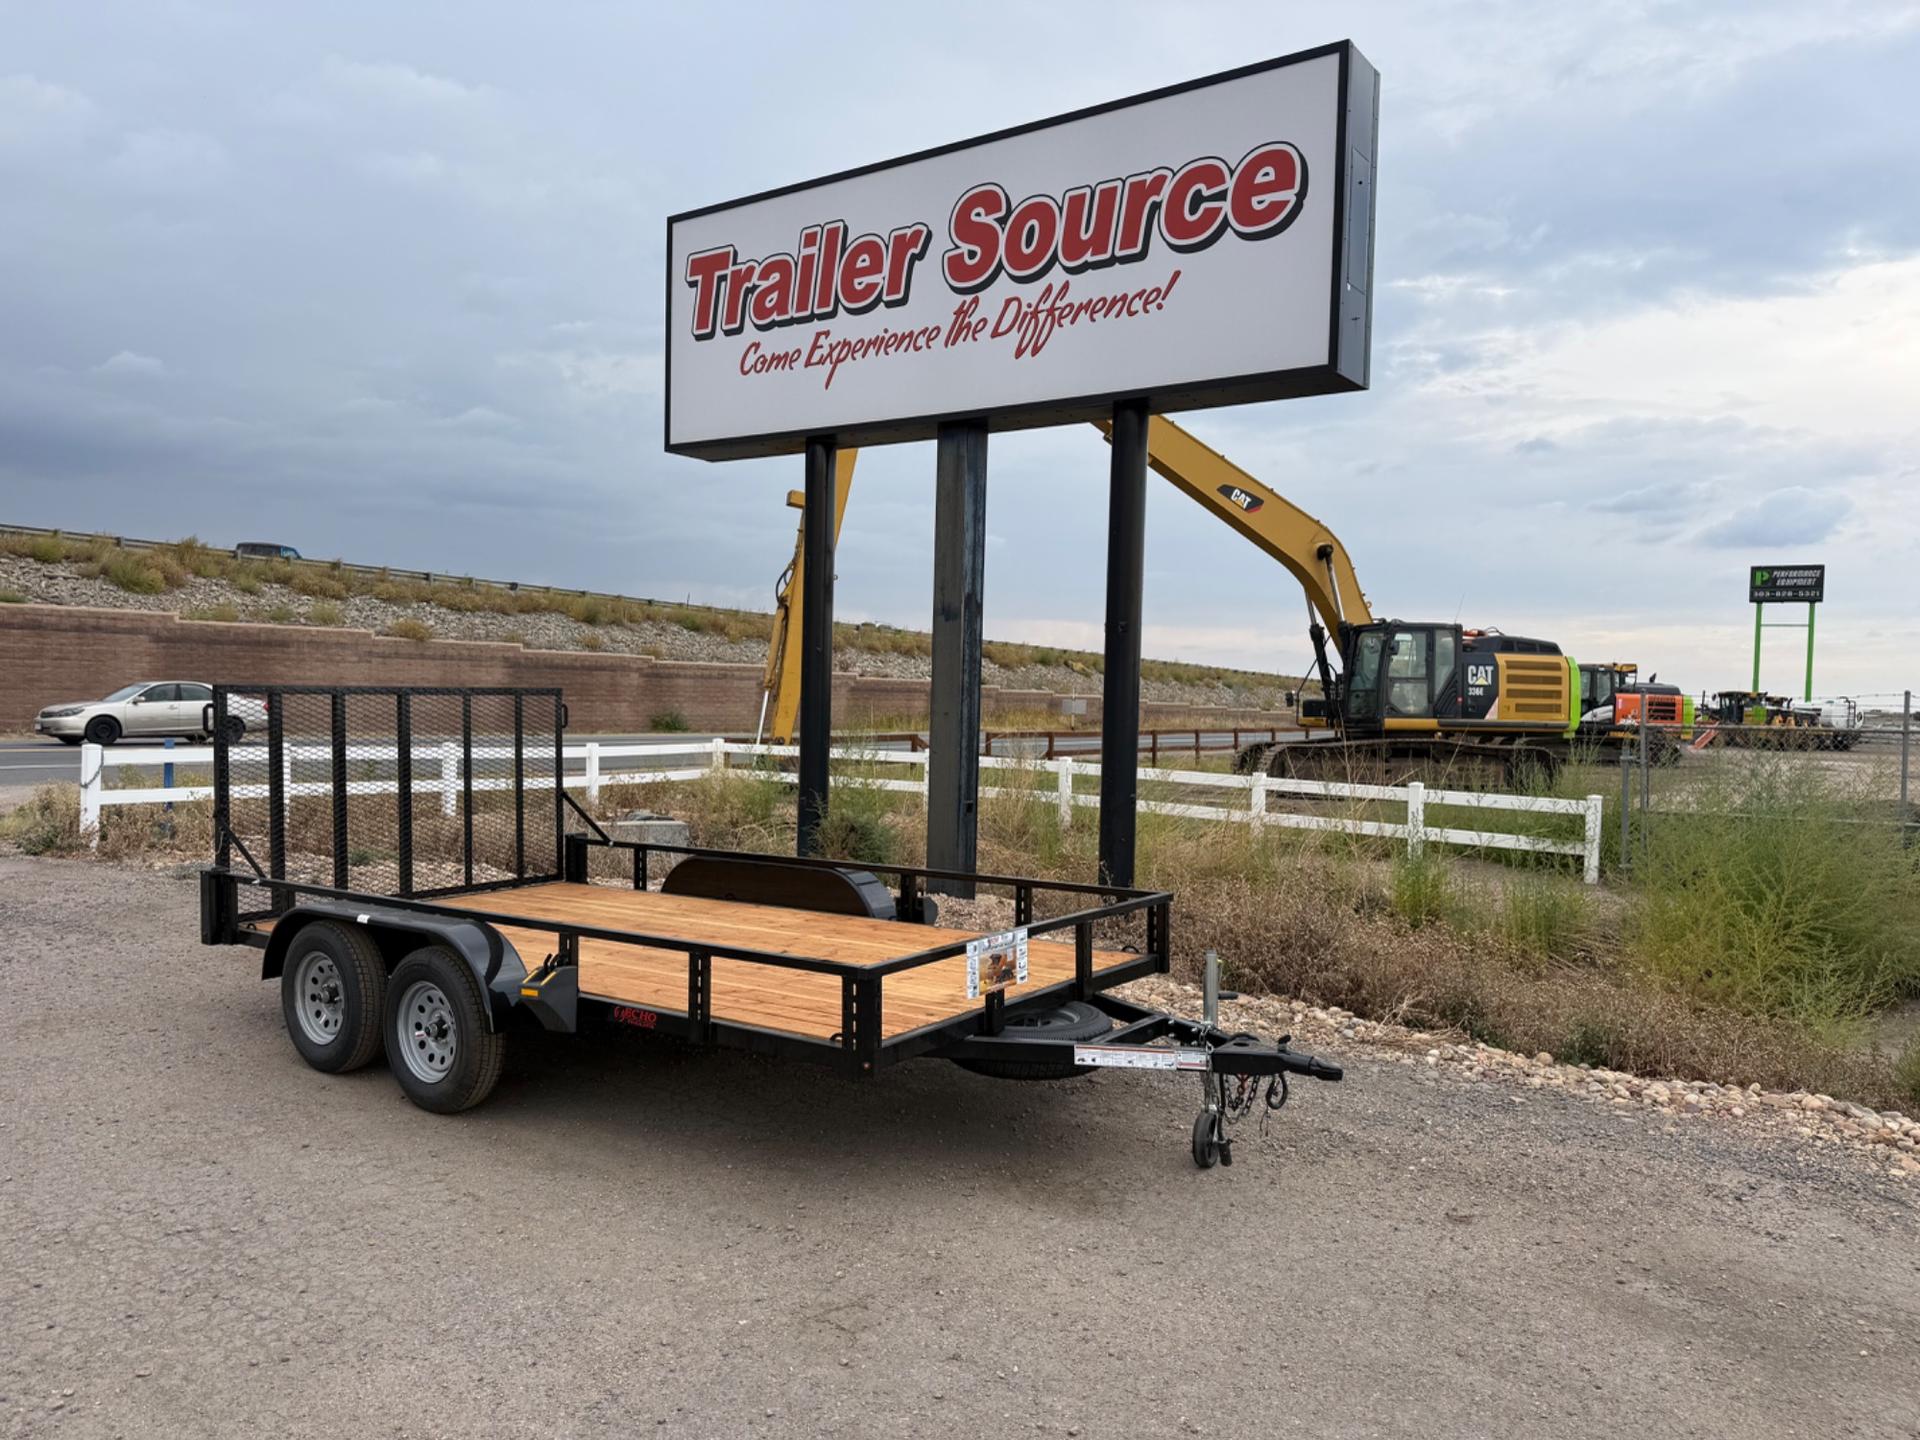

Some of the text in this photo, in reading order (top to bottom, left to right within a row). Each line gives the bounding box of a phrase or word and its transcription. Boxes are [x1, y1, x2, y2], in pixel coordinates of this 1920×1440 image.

[686, 140, 1309, 341] Trailer Source
[738, 270, 1182, 390] Come Experience the Difference!
[1231, 488, 1252, 509] CAT
[1772, 570, 1821, 578] PERFORMANCE
[1776, 578, 1816, 586] EQUIPMENT
[1468, 665, 1494, 685] CAT
